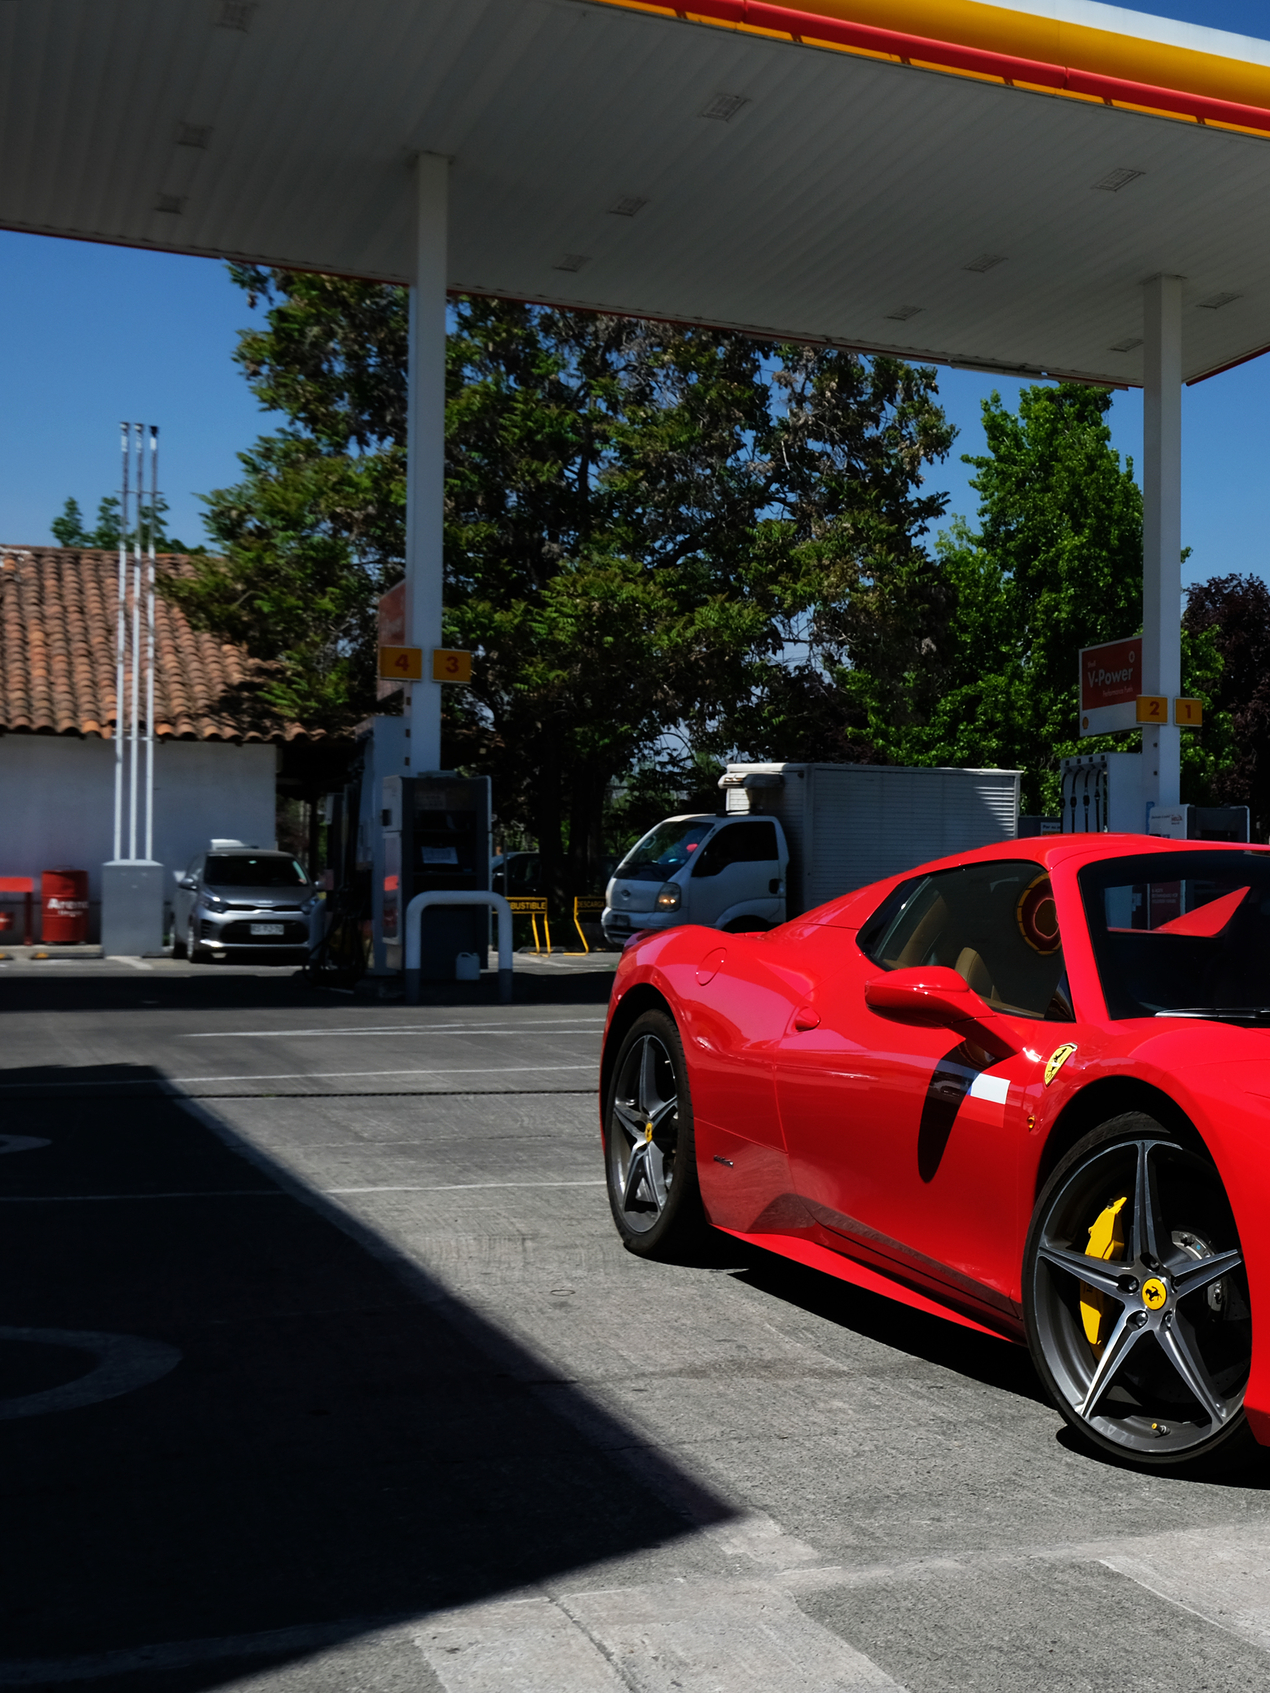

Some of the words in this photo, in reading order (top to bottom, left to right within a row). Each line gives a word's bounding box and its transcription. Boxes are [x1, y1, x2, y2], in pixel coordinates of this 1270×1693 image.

[394, 654, 410, 672] 4
[445, 655, 460, 673] 3
[1087, 667, 1134, 688] V-Power
[1149, 701, 1160, 715] 2
[1184, 704, 1192, 719] 1
